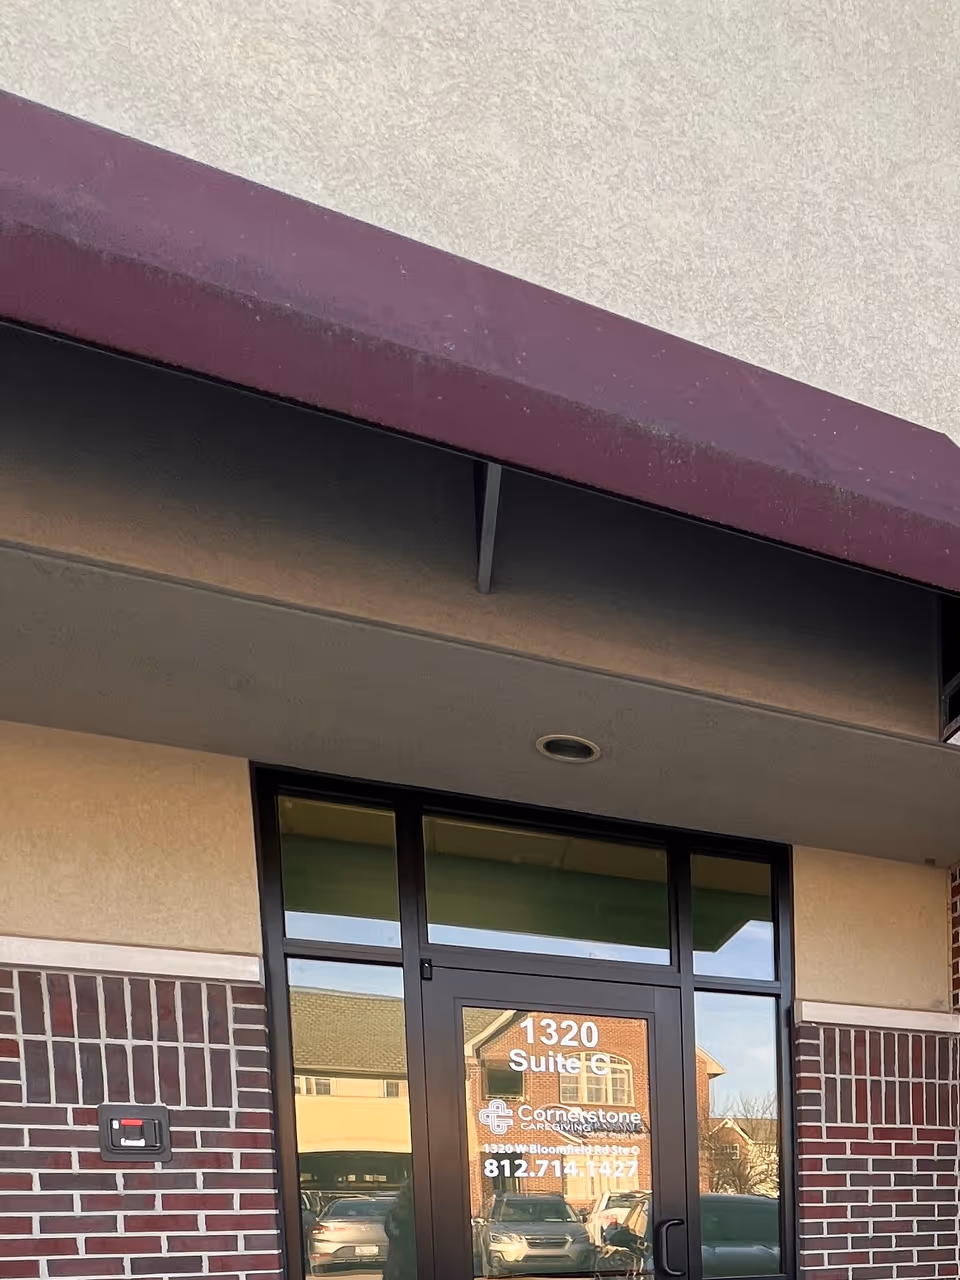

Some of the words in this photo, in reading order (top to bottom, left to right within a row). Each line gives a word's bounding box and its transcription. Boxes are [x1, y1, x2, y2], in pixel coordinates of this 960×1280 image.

[520, 1017, 599, 1048] 1320
[508, 1048, 582, 1075] Suite
[590, 1053, 611, 1076] C
[517, 1104, 642, 1125] Cornerstone
[520, 1122, 592, 1132] CAREGIVING
[483, 1143, 513, 1154] 1320
[514, 1143, 528, 1154] W
[529, 1143, 592, 1155] Bloomfield
[483, 1158, 639, 1178] 812.714.1427
